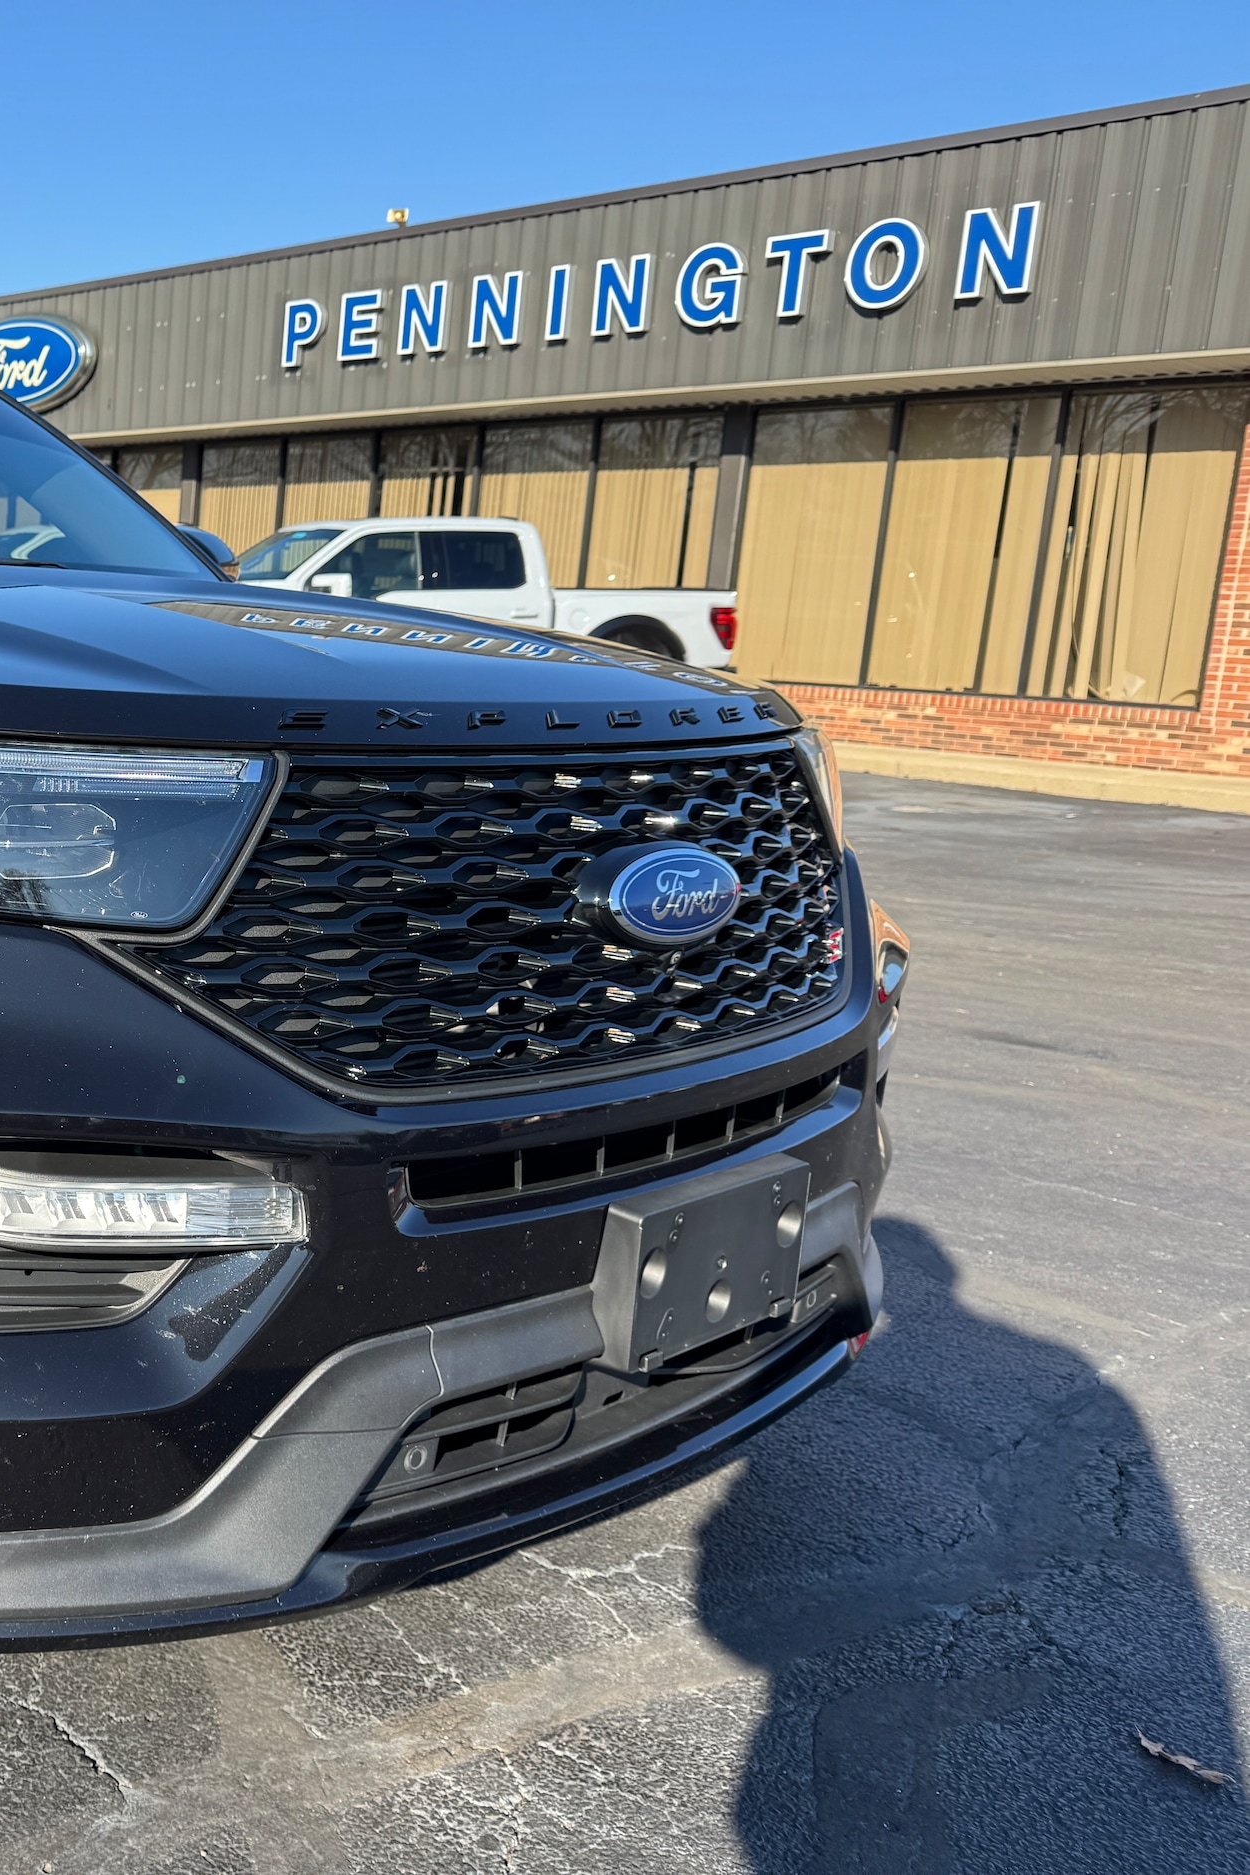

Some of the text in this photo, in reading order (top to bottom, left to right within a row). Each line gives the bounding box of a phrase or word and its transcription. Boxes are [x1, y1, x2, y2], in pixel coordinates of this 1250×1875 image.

[281, 200, 1042, 368] PENNINGTON
[277, 701, 778, 731] EXPLORER
[651, 868, 718, 921] Ford
